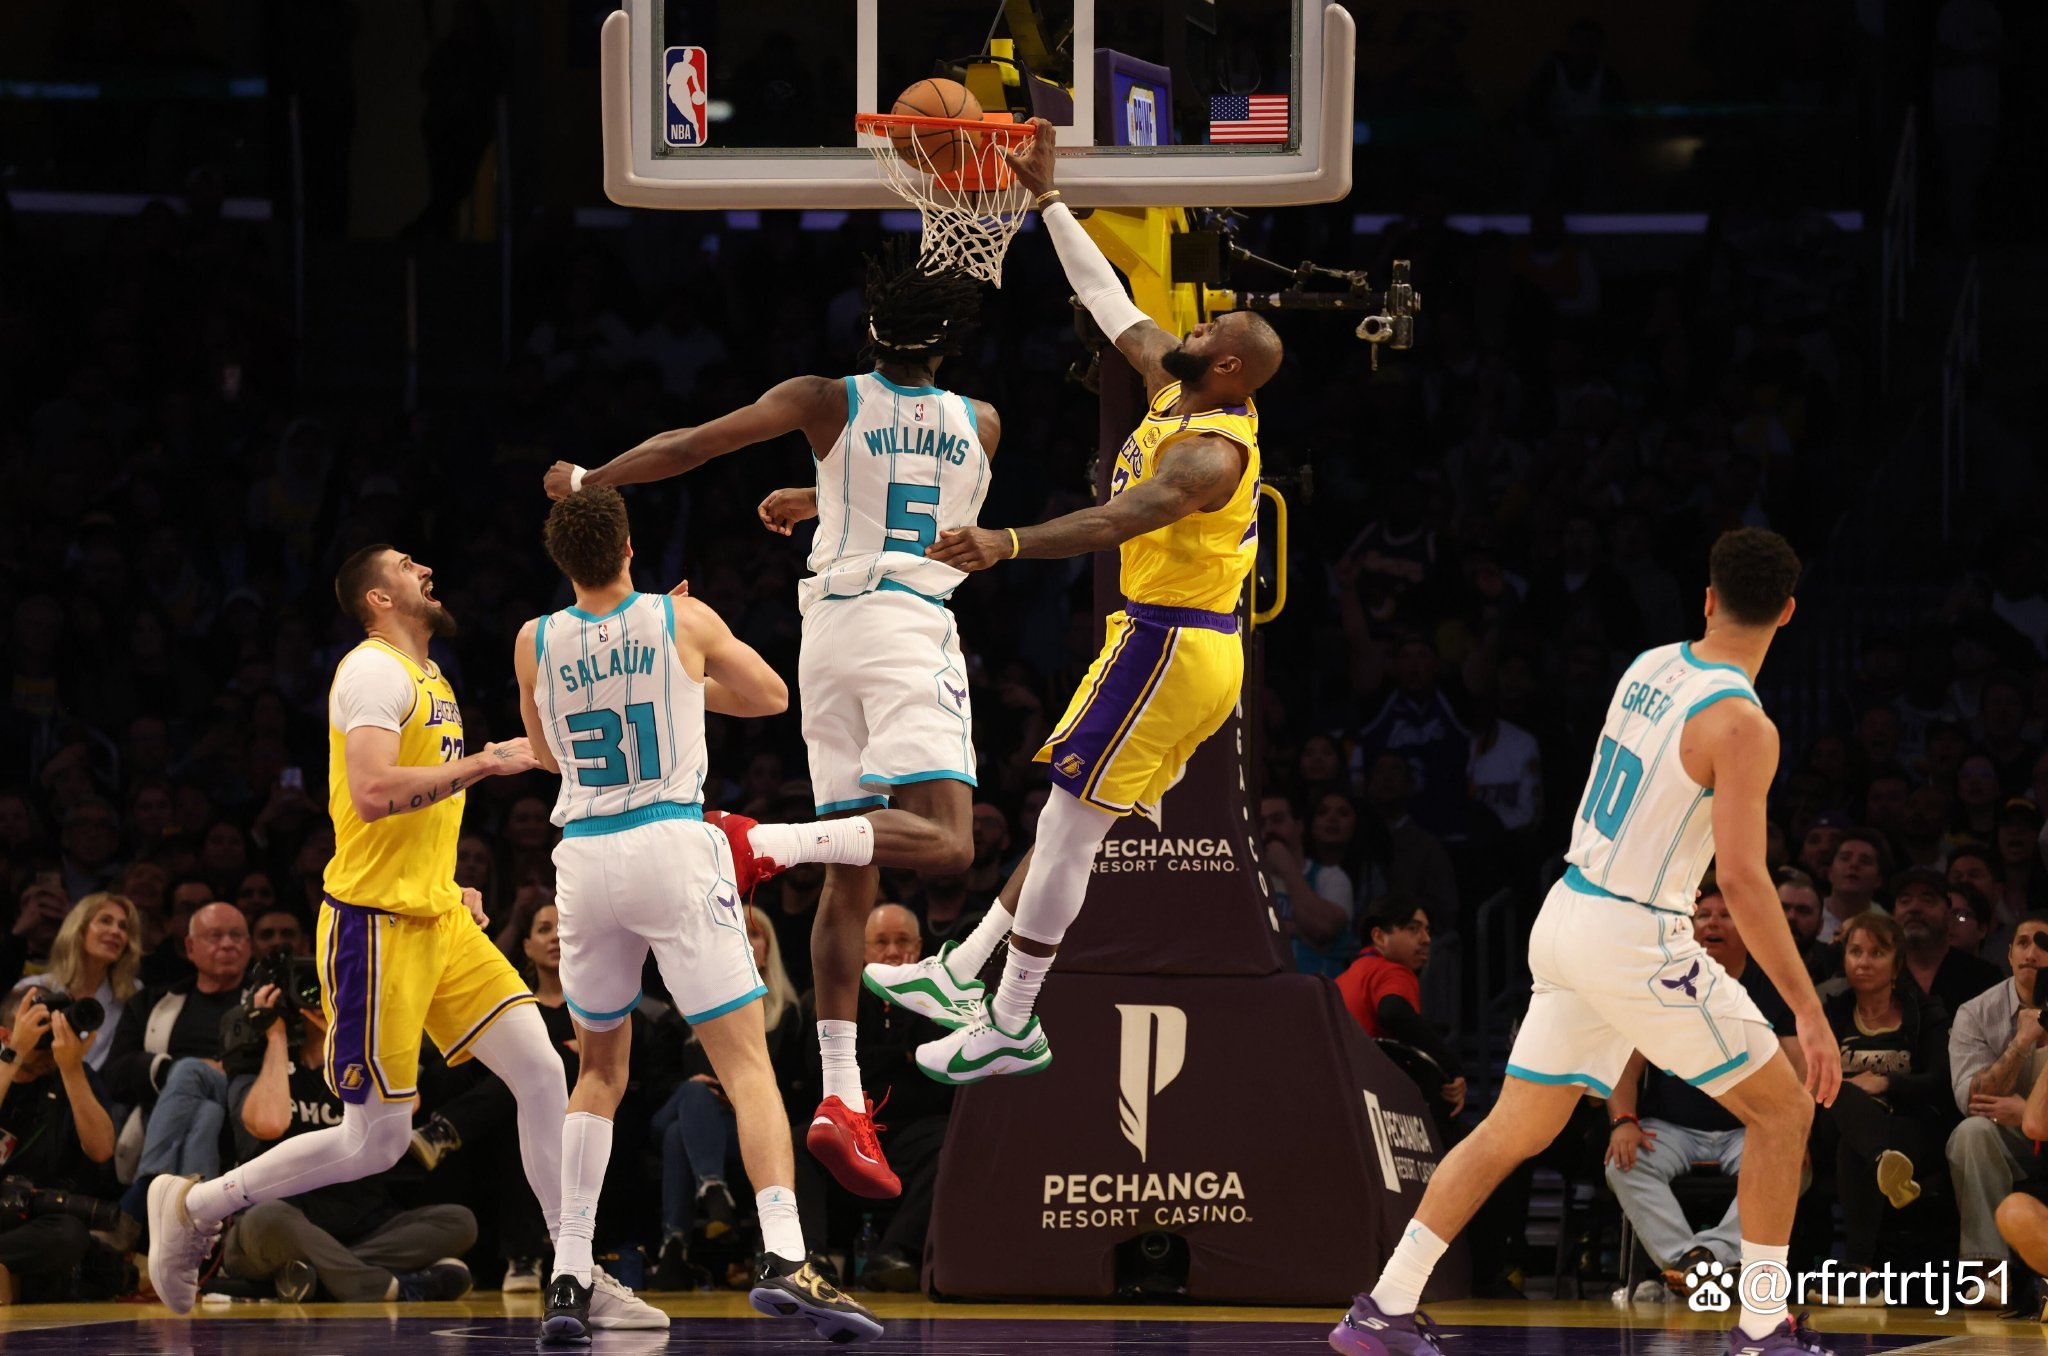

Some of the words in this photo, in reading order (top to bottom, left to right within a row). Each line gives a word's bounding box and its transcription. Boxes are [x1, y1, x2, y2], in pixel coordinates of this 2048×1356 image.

[671, 124, 691, 140] NBA
[864, 427, 969, 466] WILLIAMS
[883, 482, 941, 557] 5
[559, 639, 656, 693] SALAÜN
[565, 701, 661, 787] 31
[388, 778, 464, 814] LOVE
[1581, 734, 1644, 842] 10
[1168, 859, 1235, 872] CASINO
[1044, 1171, 1245, 1204] PECHANGA
[1042, 1208, 1139, 1229] RESORT
